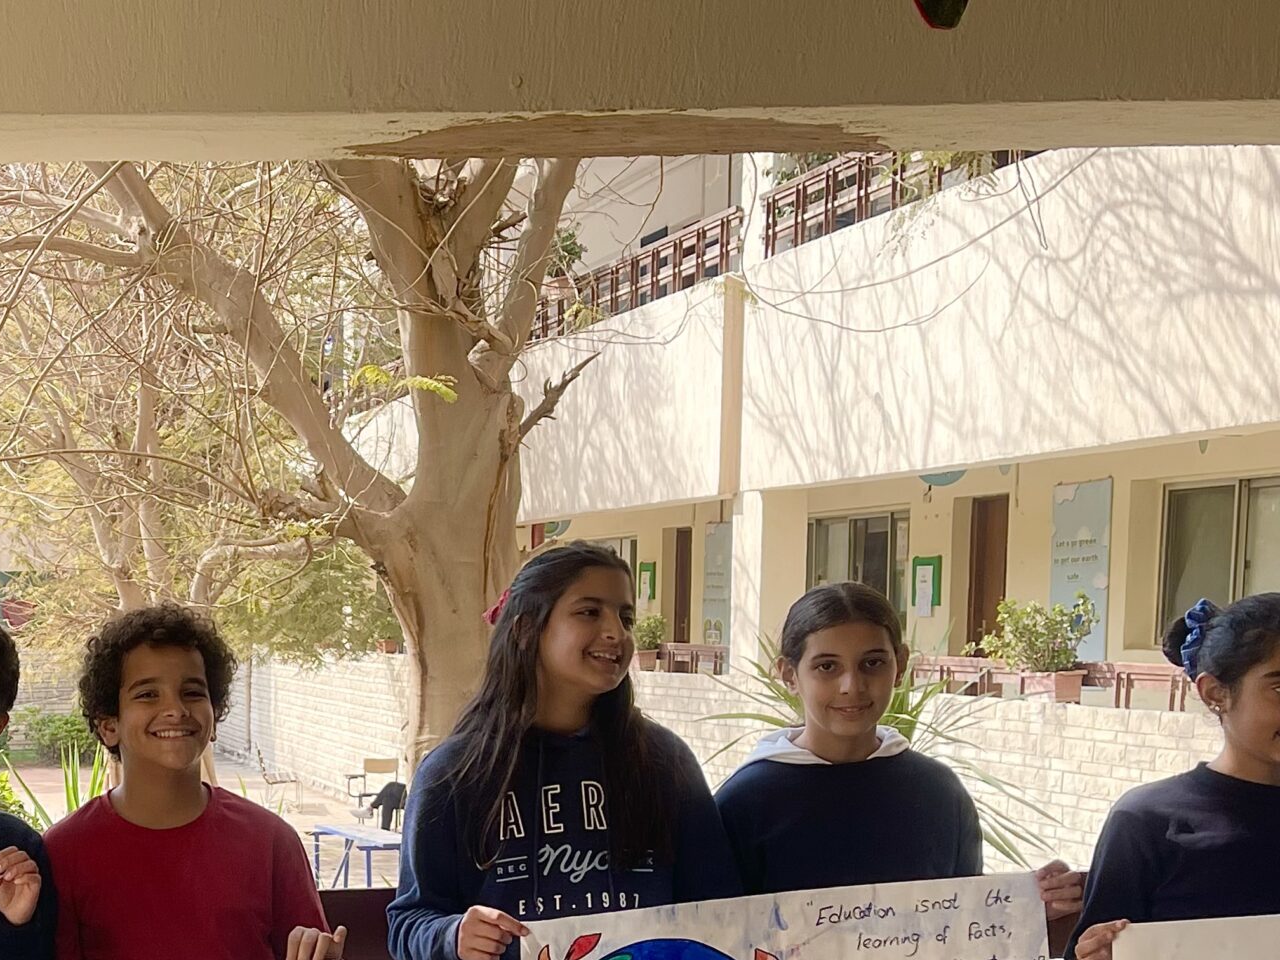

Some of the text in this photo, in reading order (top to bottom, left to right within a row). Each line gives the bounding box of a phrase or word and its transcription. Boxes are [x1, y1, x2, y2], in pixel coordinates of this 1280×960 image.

[500, 780, 608, 840] AER
[497, 863, 527, 875] REG
[985, 888, 1013, 907] the
[935, 925, 950, 945] of
